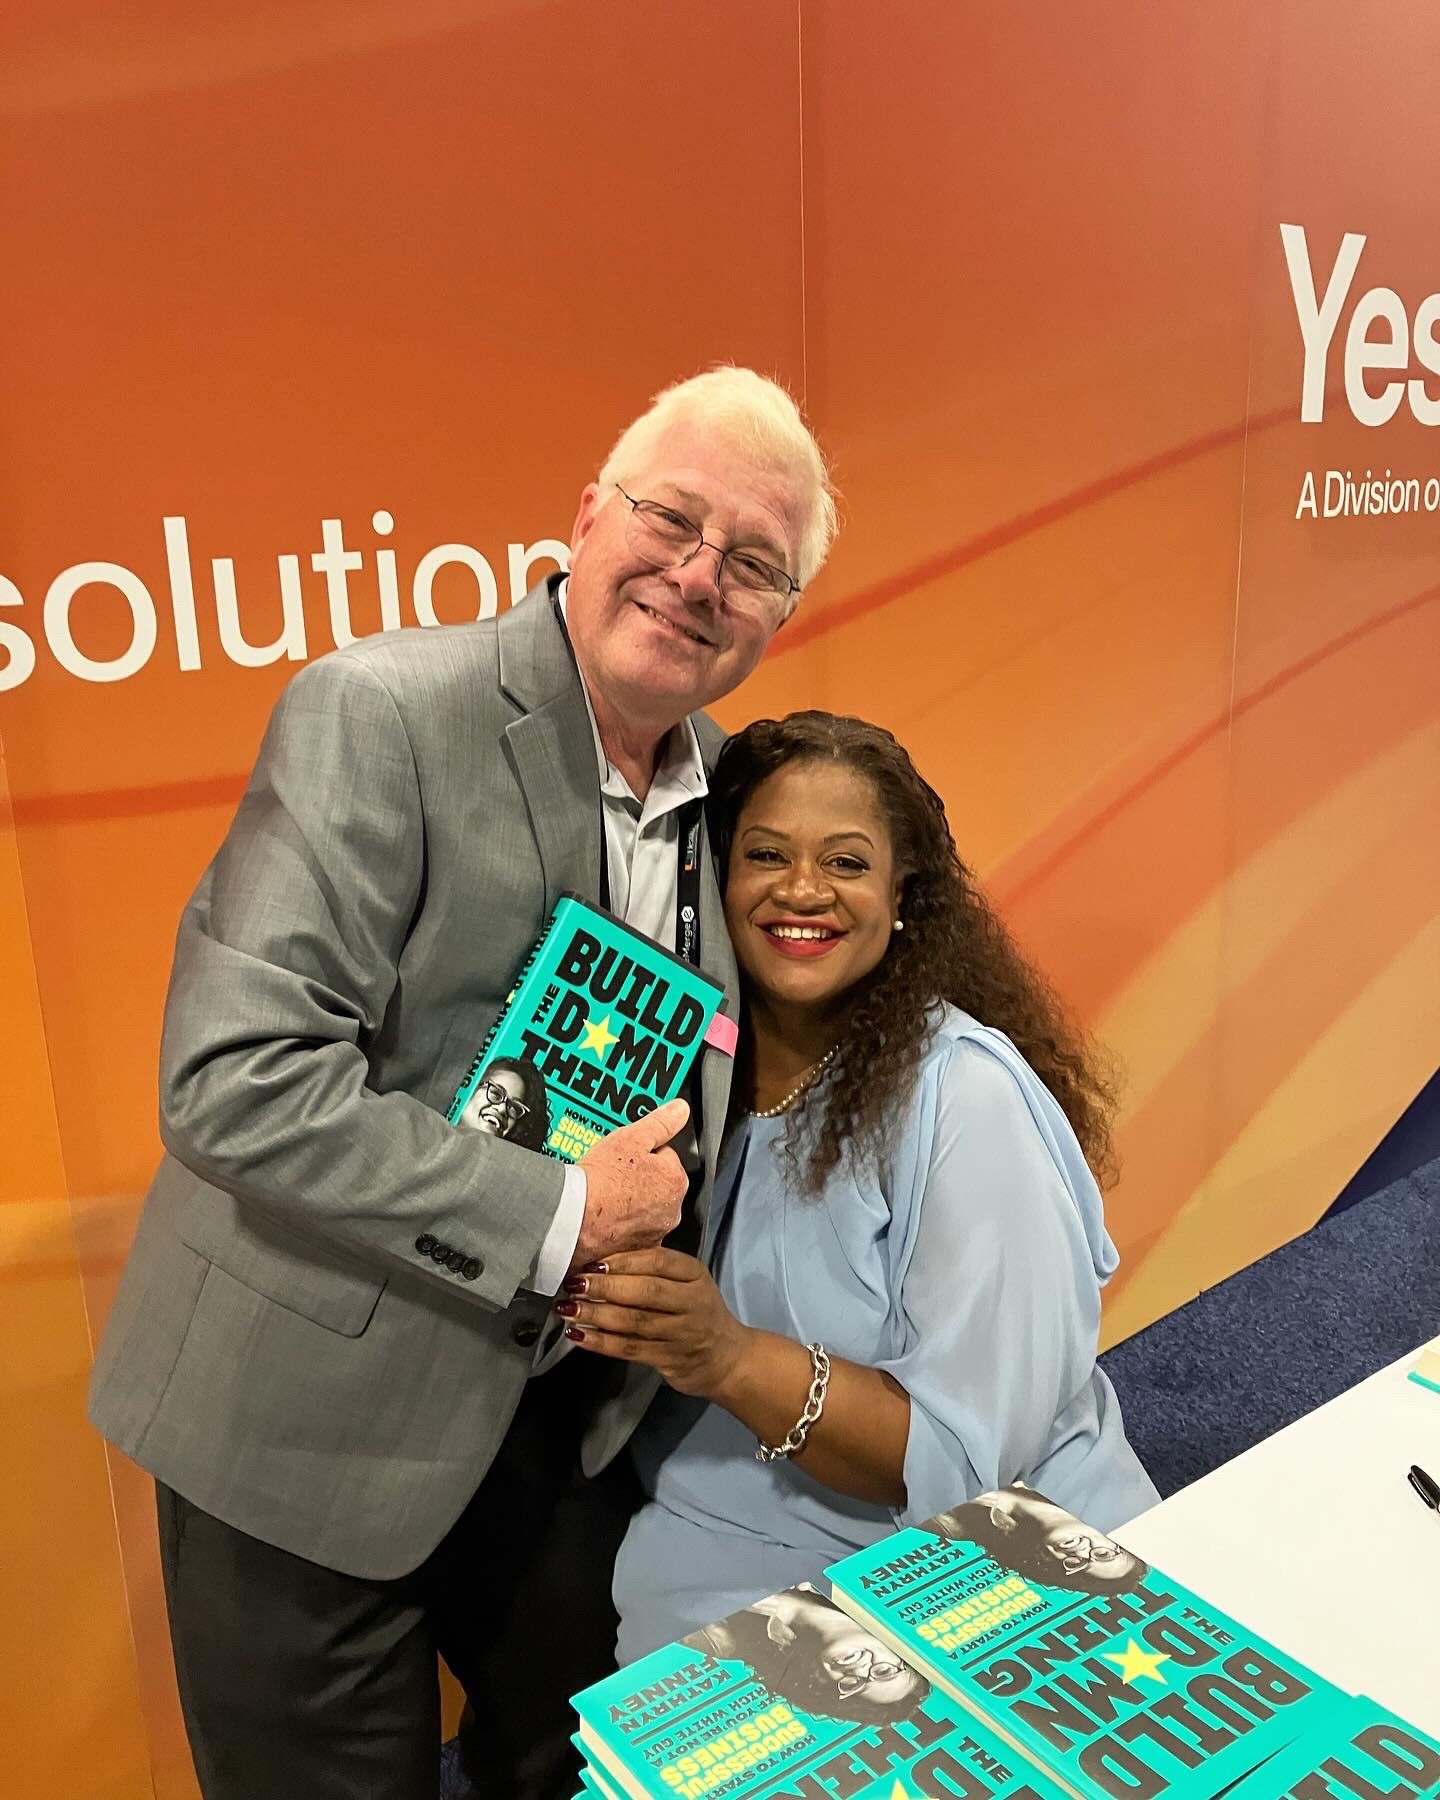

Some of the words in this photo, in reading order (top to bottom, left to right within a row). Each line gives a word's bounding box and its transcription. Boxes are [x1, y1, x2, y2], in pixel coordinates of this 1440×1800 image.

[1280, 223, 1440, 427] Yes
[1295, 471, 1318, 519] A
[1323, 469, 1420, 518] Division
[1424, 478, 1440, 511] o
[555, 928, 704, 1048] BUILD
[531, 984, 558, 1024] THE
[564, 1107, 589, 1125] HOW
[590, 1121, 602, 1133] TO
[859, 1536, 953, 1590] FINNEY
[871, 1549, 966, 1599] KATHRYN
[968, 1562, 1000, 1586] RICH
[927, 1579, 969, 1605] WHITE
[949, 1575, 993, 1605] YOU'RE
[897, 1601, 924, 1619] GUY
[906, 1615, 919, 1626] A
[916, 1576, 1028, 1640] BUSINESS
[921, 1602, 949, 1620] NOT
[930, 1589, 1043, 1653] SUCCESSFUL
[1019, 1600, 1052, 1622] HOW
[1002, 1618, 1022, 1631] TO
[1182, 1607, 1236, 1646] THE
[946, 1651, 959, 1661] A
[960, 1628, 1002, 1655] START
[970, 1583, 1179, 1698] THING
[608, 1654, 720, 1723] FINNEY
[619, 1669, 732, 1735] KATHRYN
[728, 1685, 767, 1711] RICH
[675, 1708, 729, 1741] WHITE
[703, 1707, 755, 1741] YOU'RE
[1078, 1646, 1313, 1800] BUILD
[642, 1738, 674, 1760] GUY
[660, 1704, 794, 1786] BUSINESS
[667, 1739, 699, 1761] NOT
[675, 1720, 808, 1800] SUCCESSFUL
[779, 1734, 817, 1760] HOW
[958, 1735, 1015, 1785] THE
[650, 1757, 664, 1768] A
[756, 1757, 779, 1772] TO
[705, 1770, 756, 1800] START
